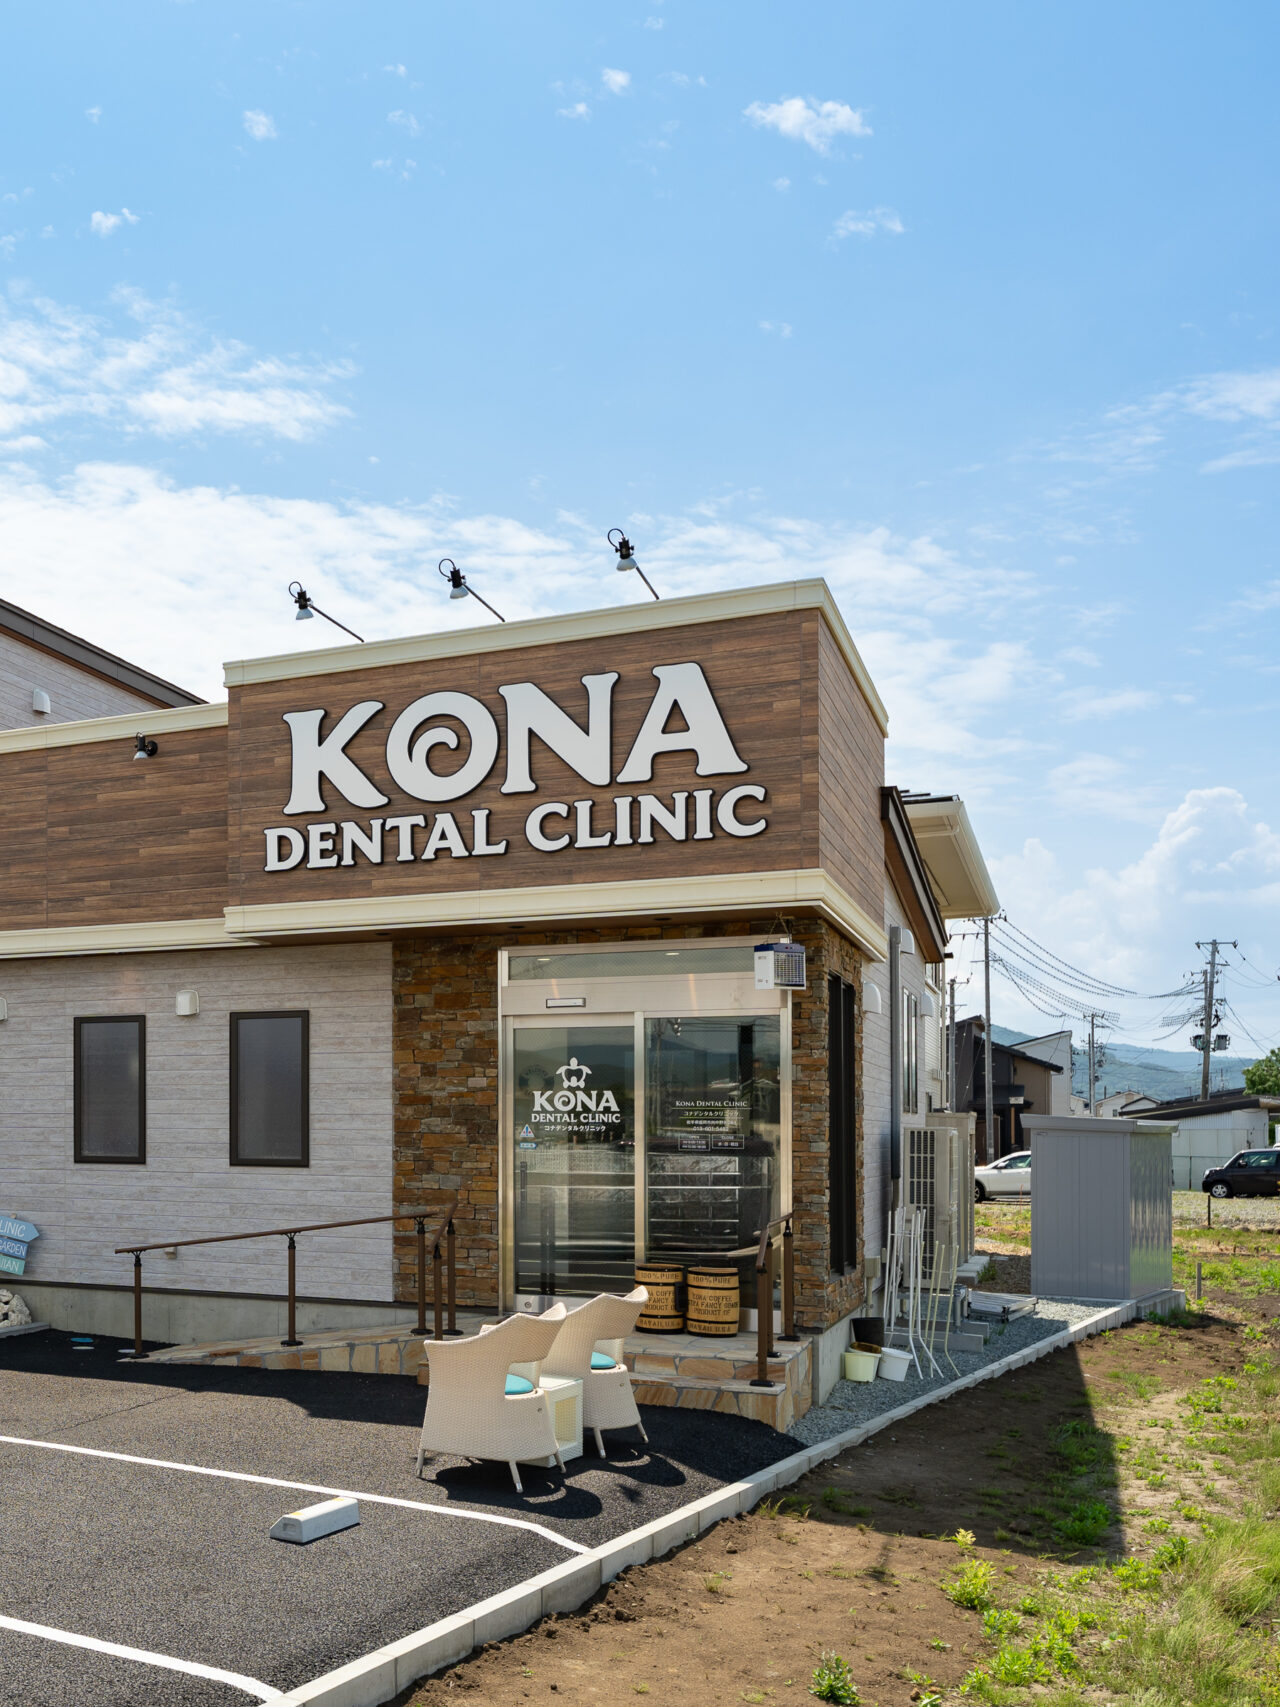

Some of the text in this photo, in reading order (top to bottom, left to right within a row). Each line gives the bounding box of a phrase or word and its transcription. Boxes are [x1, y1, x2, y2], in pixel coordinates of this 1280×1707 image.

[282, 661, 750, 816] KONA
[263, 783, 767, 872] DENTAL CLINIC
[531, 1113, 621, 1123] DENTAL CLINIC
[532, 1090, 620, 1112] KONA
